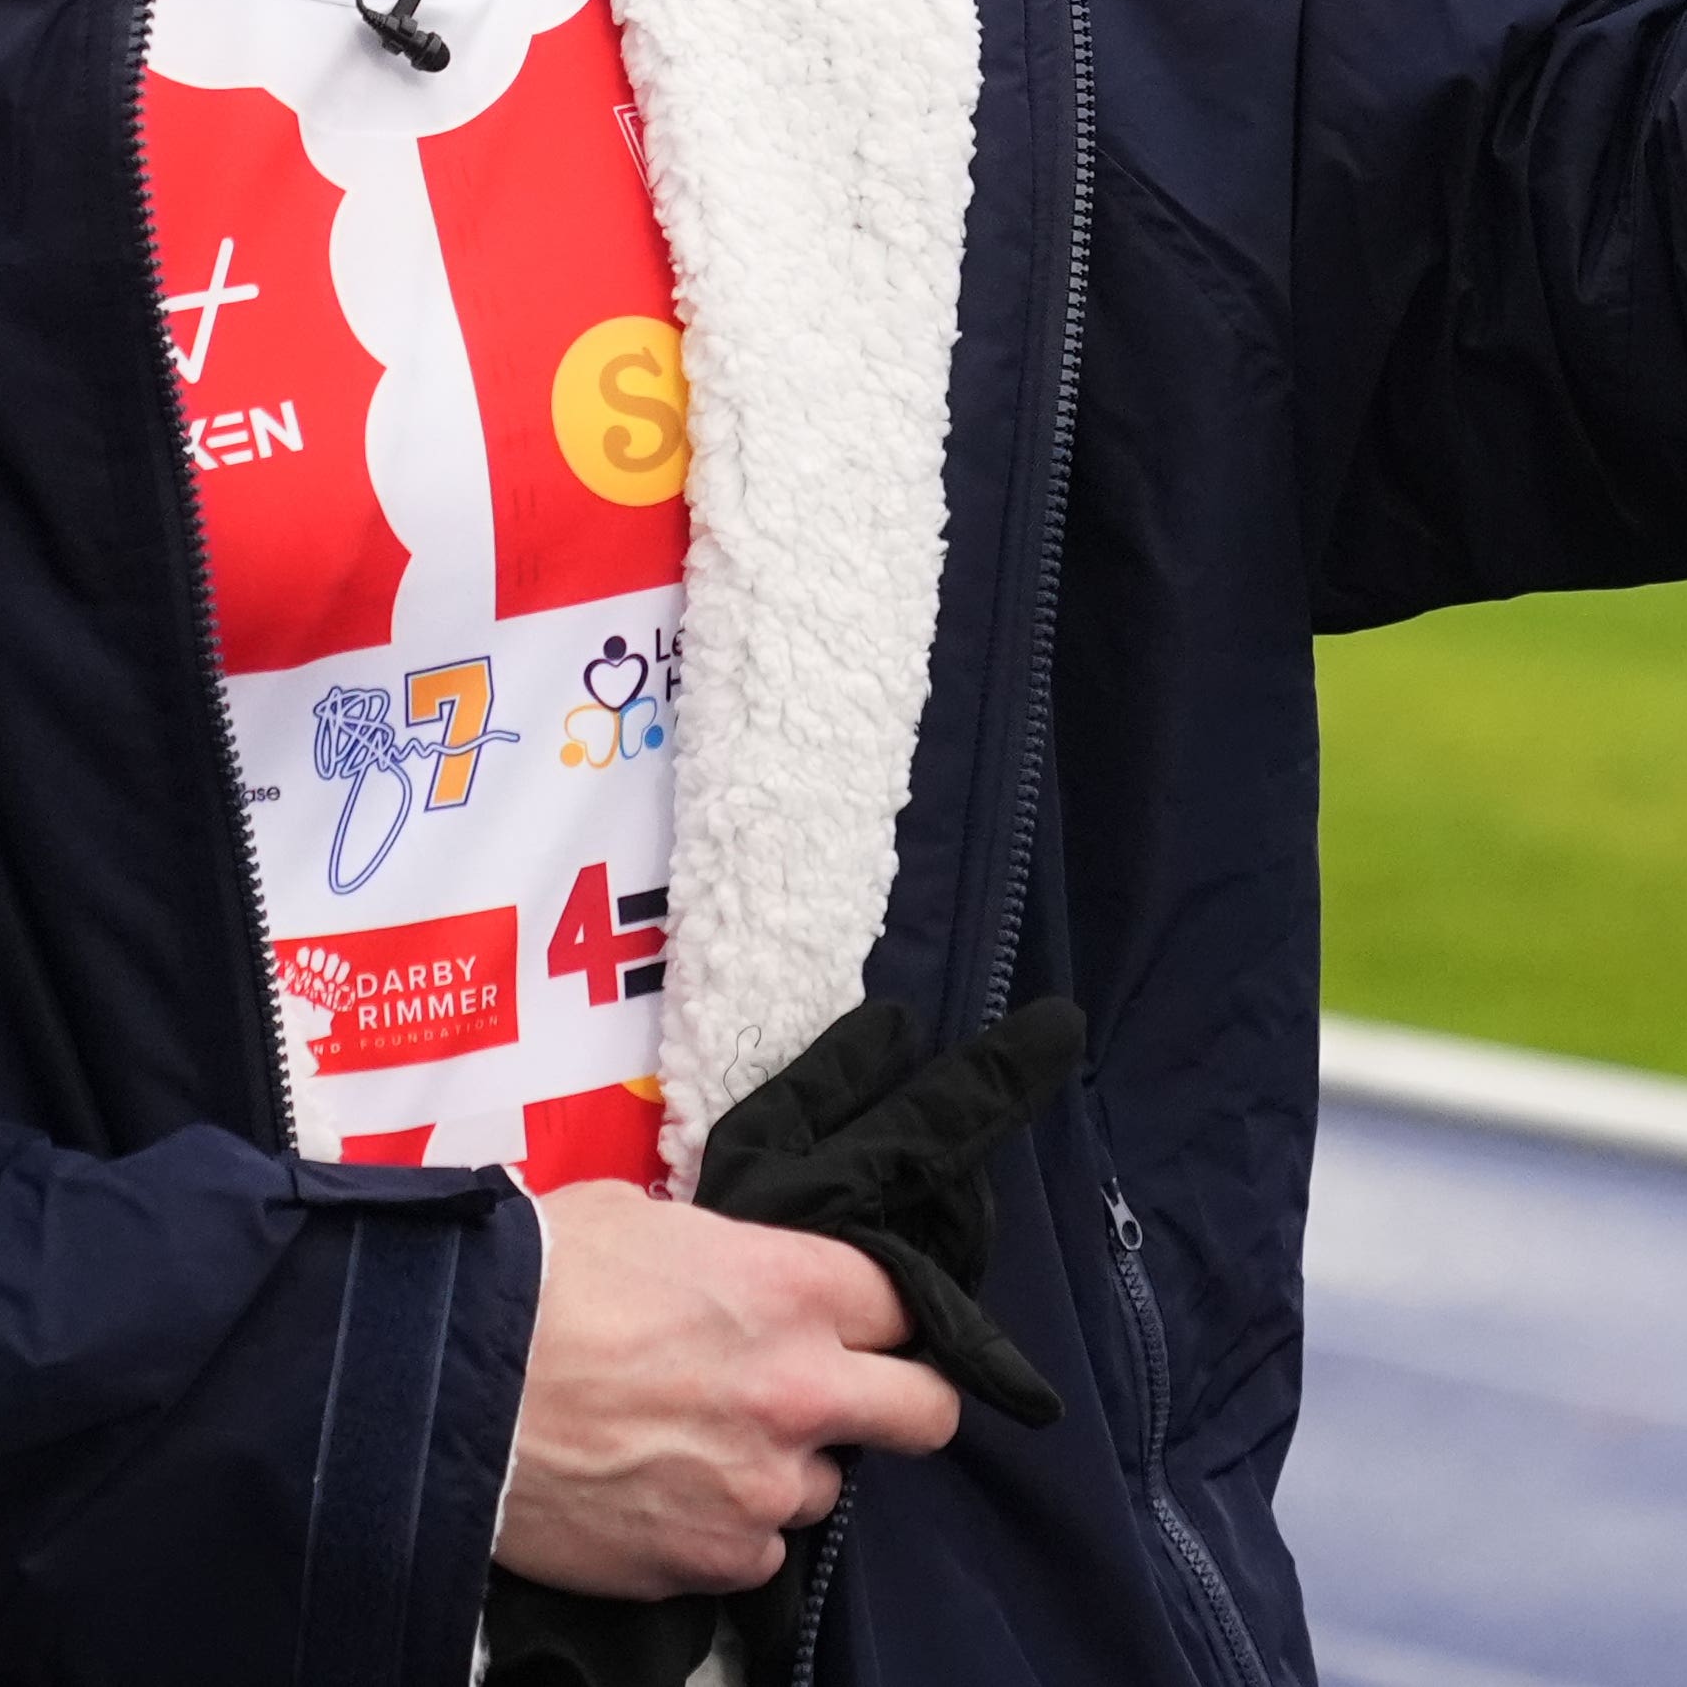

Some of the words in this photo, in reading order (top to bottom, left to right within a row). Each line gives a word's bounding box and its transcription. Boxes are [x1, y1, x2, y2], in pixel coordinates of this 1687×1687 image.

[182, 399, 305, 471] XEN
[405, 655, 495, 812] 7
[241, 786, 281, 803] ase
[356, 955, 477, 999] DARBY
[358, 984, 498, 1031] RIMMER
[359, 1015, 499, 1051] FOUNDATION
